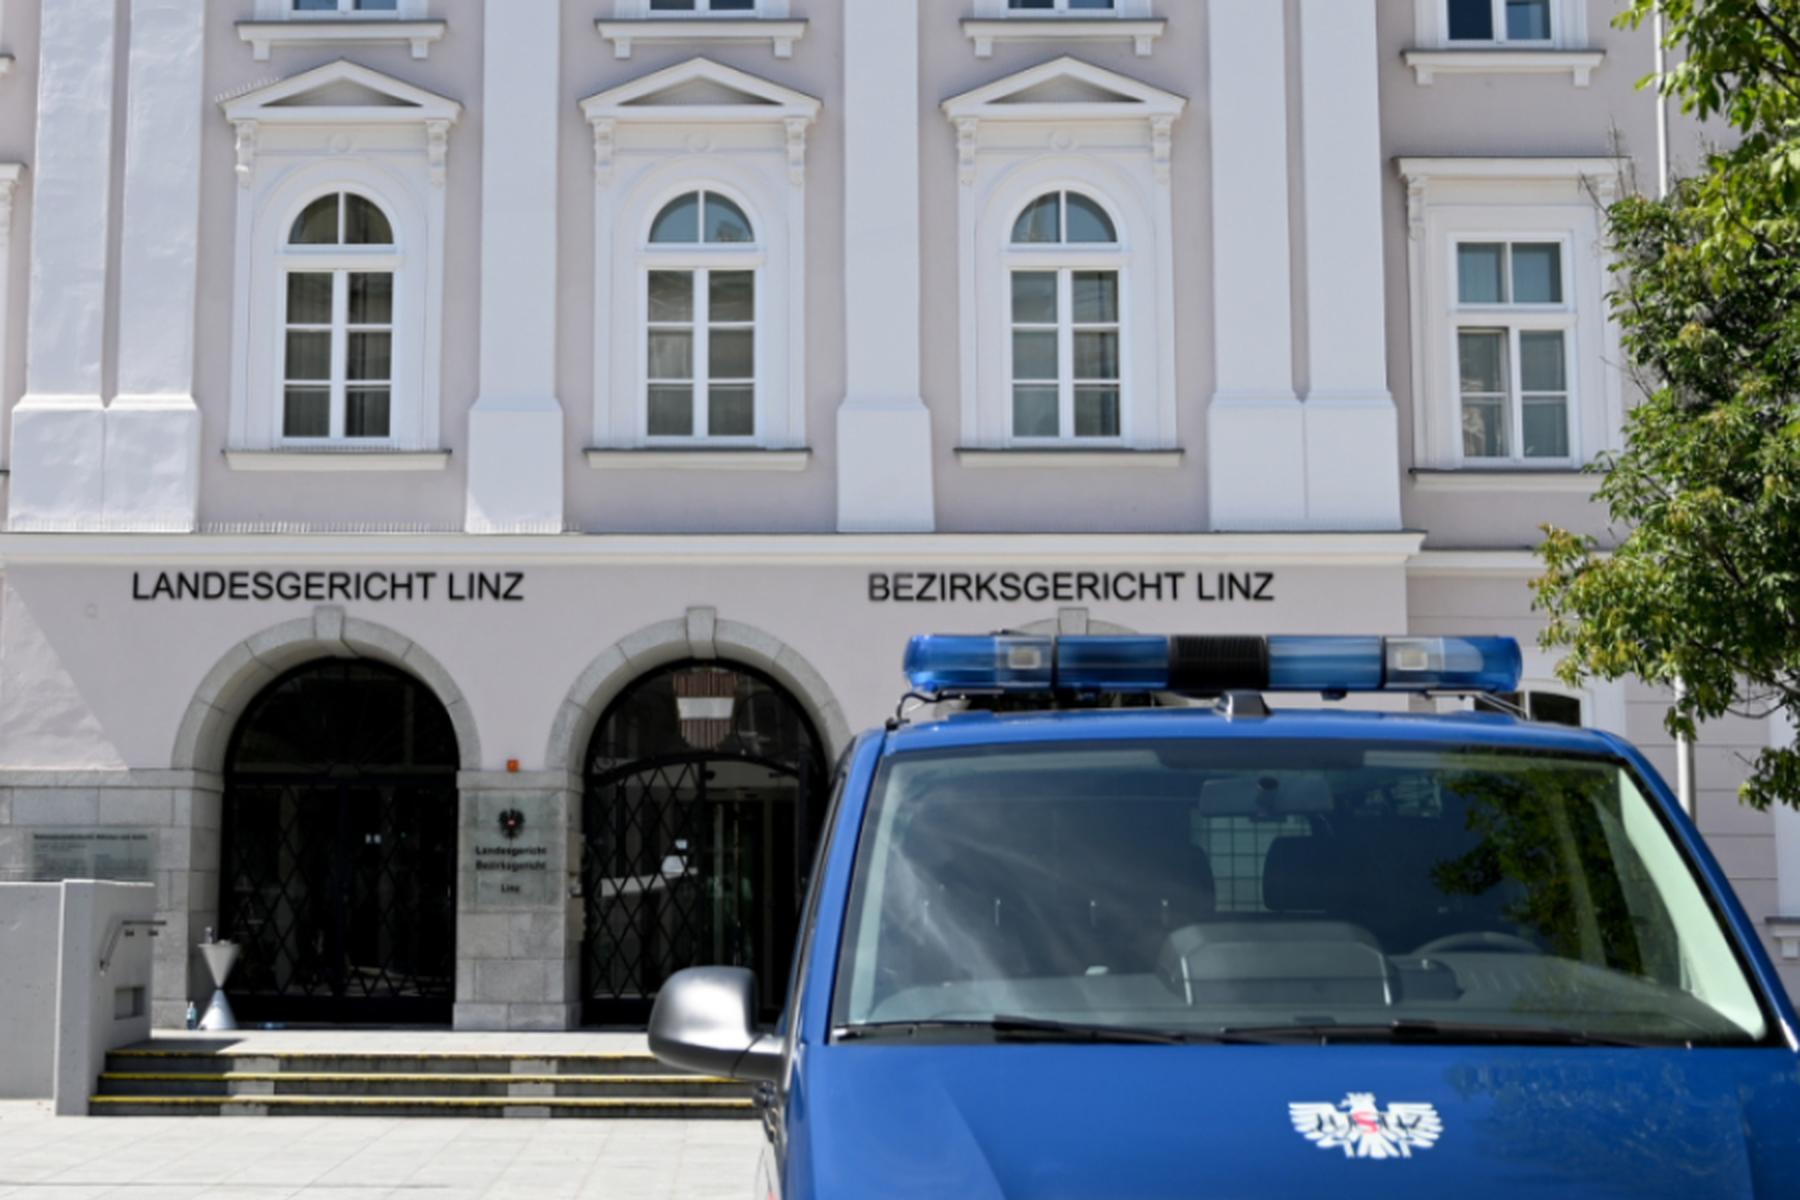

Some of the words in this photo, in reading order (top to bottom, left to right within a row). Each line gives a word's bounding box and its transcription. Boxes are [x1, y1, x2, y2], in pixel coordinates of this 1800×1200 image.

[132, 570, 438, 602] LANDESGERICHT
[447, 571, 525, 602] LINZ
[867, 571, 1187, 602] BEZIRKSGERICHT
[1197, 571, 1275, 602] LINZ
[475, 845, 547, 857] Landesgericht
